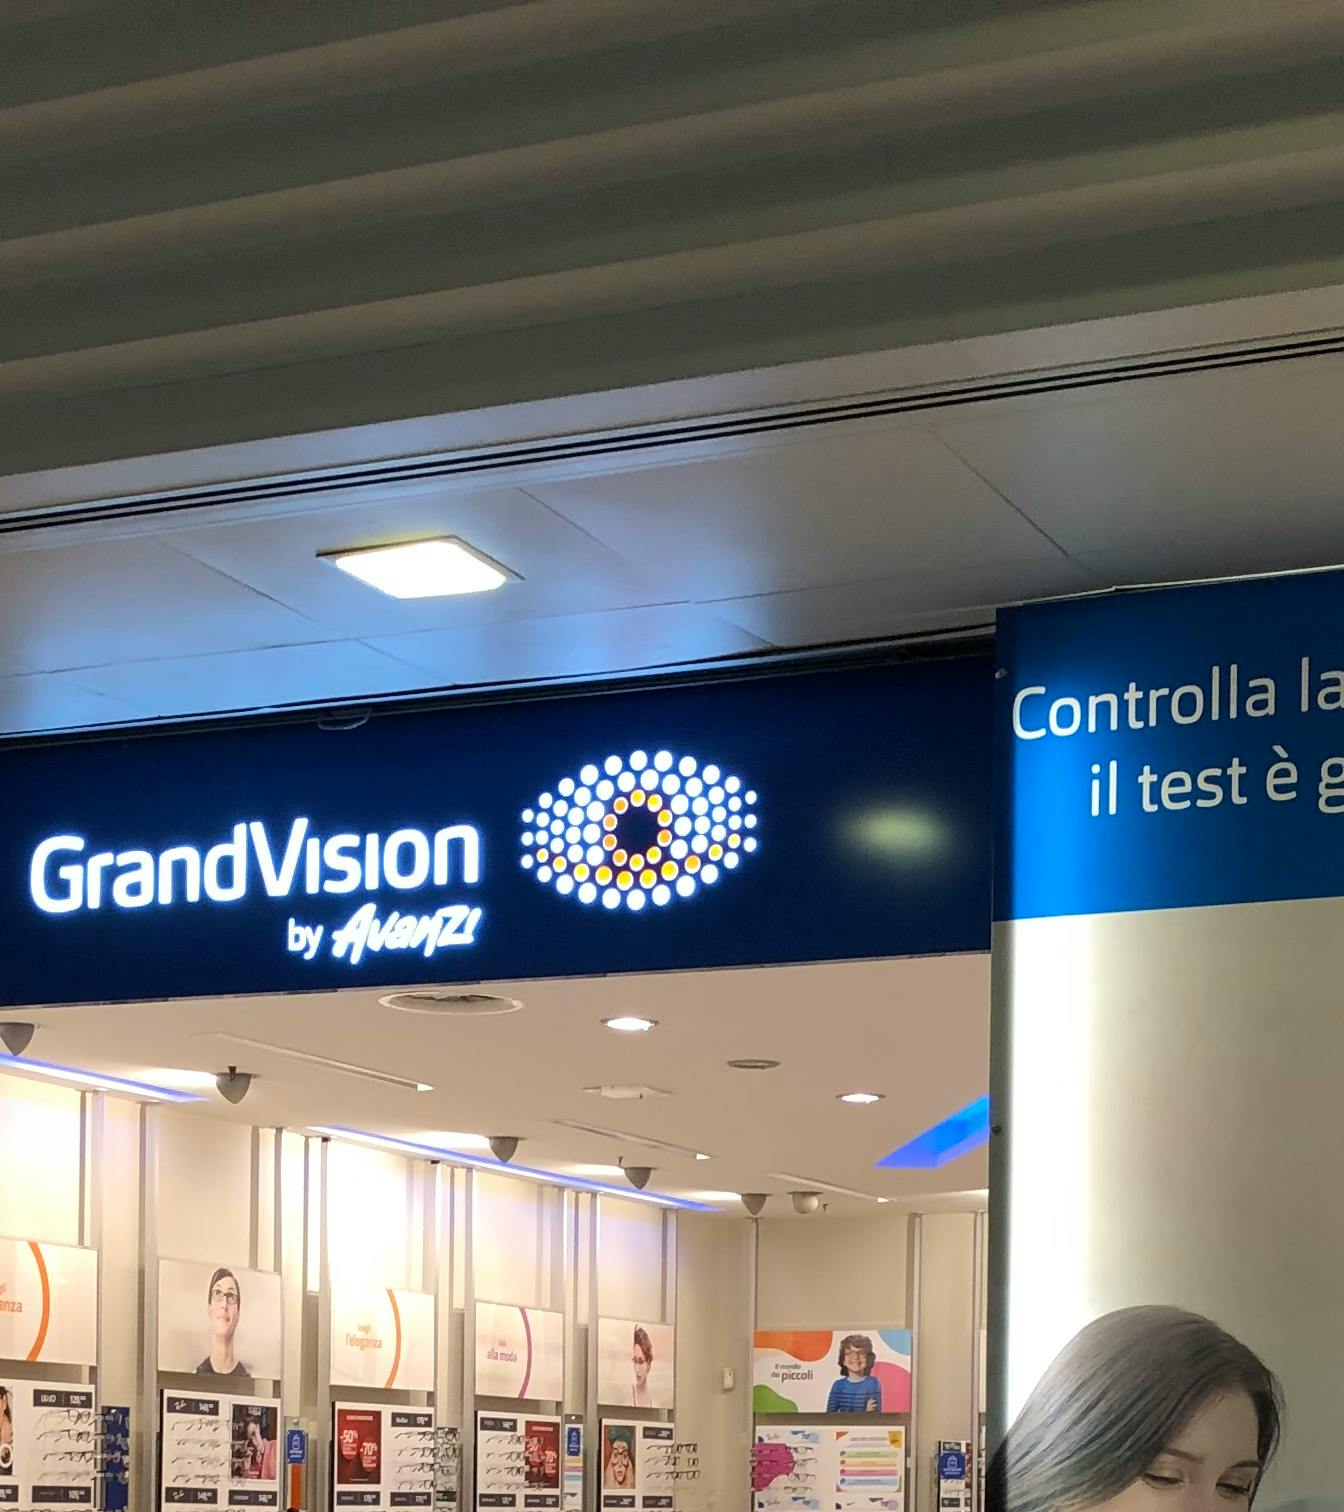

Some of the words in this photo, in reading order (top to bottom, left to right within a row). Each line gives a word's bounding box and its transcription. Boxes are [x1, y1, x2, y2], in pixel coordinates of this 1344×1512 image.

[1013, 663, 1277, 741] Controlla
[1090, 760, 1119, 817] il
[1138, 756, 1248, 813] test
[1265, 744, 1299, 802] è
[29, 816, 480, 914] GrandVision
[287, 917, 324, 960] by
[781, 1369, 814, 1383] piccoli
